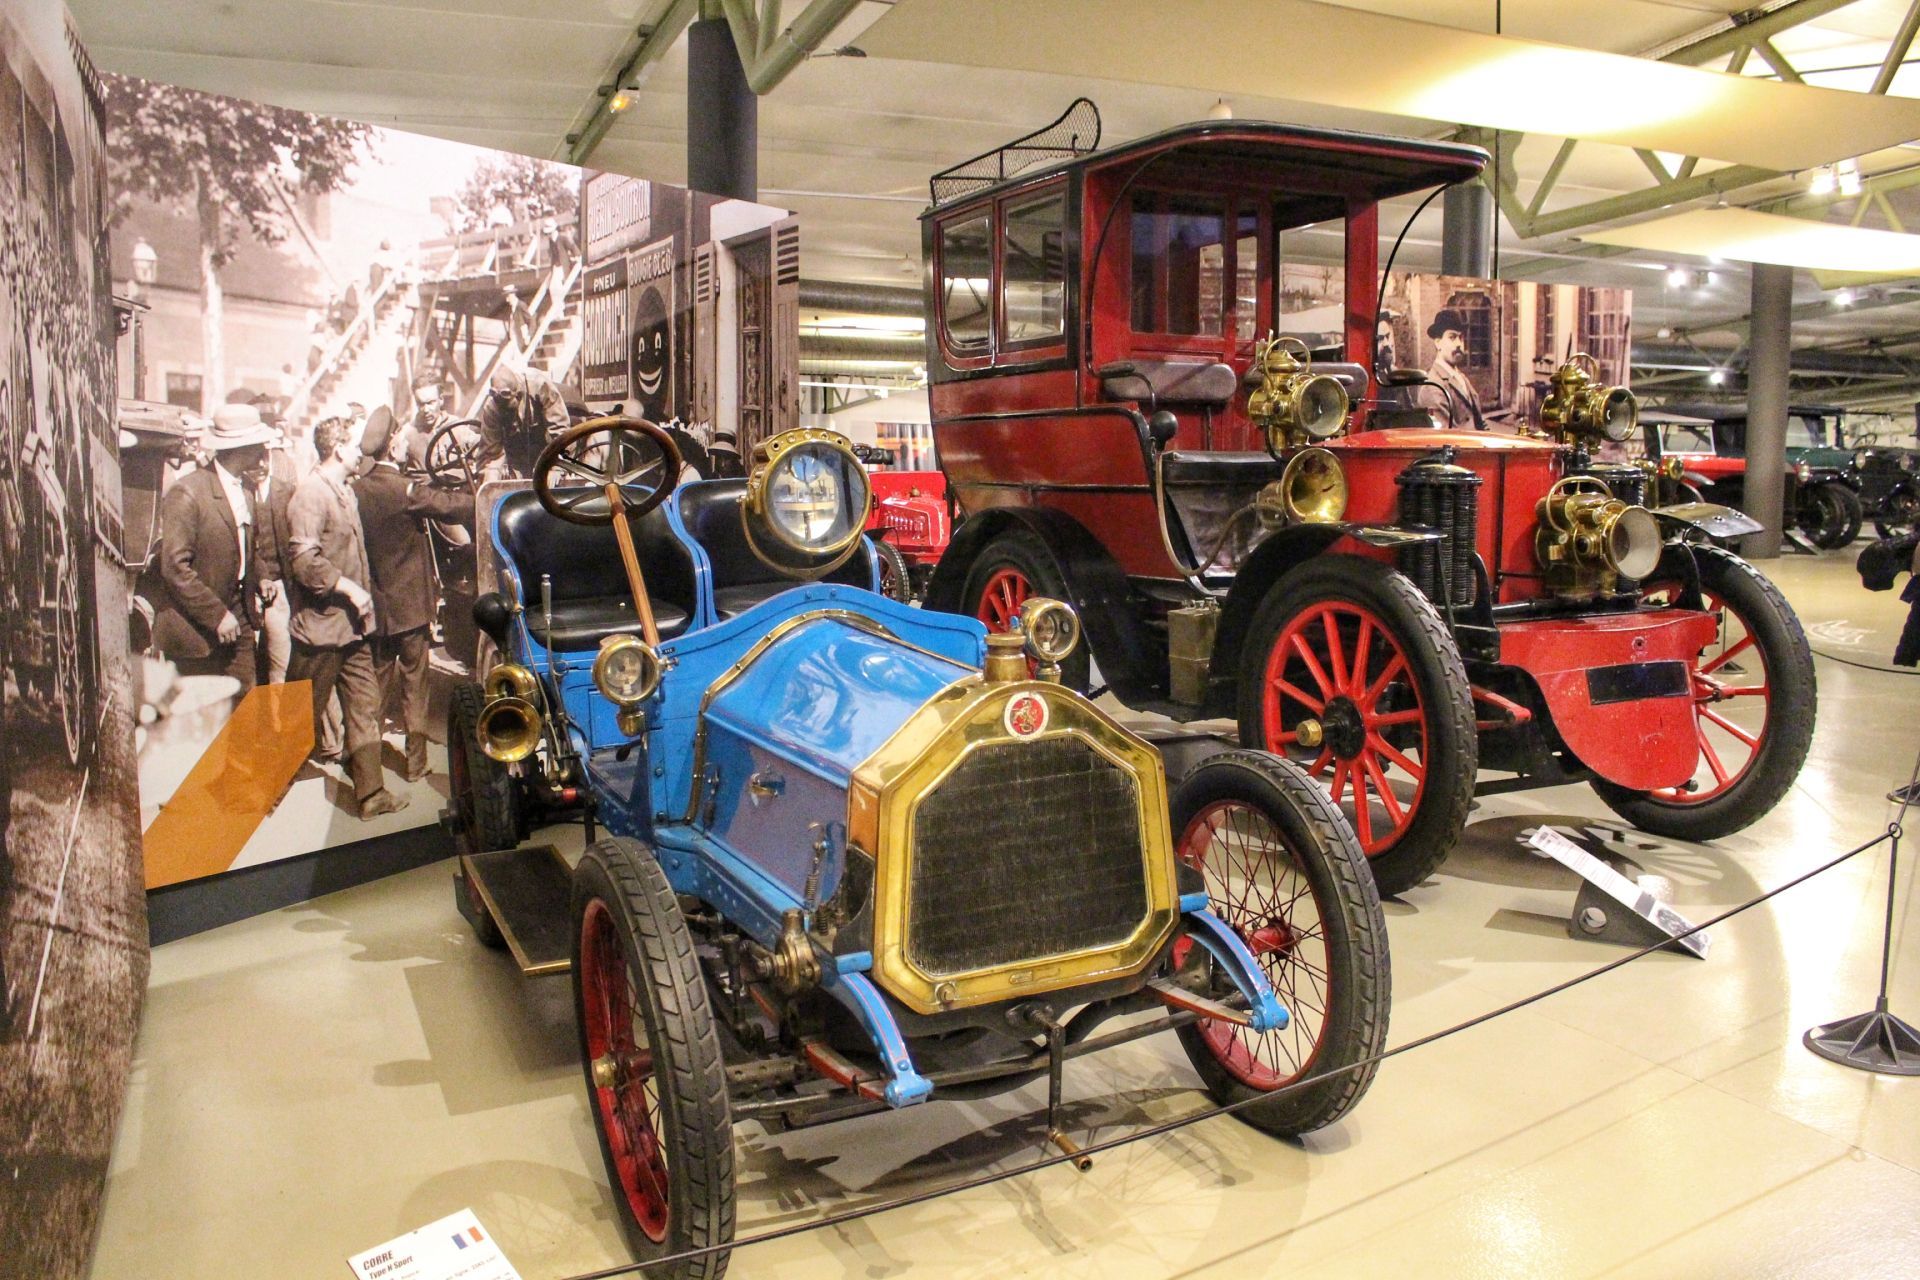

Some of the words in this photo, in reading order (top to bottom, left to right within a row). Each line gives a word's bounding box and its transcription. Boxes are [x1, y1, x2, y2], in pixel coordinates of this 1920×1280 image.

[593, 272, 616, 293] PNEU
[584, 289, 627, 367] GOODRICH
[363, 1250, 394, 1271] CORRE
[369, 1268, 387, 1280] Type
[393, 1256, 413, 1269] Sport
